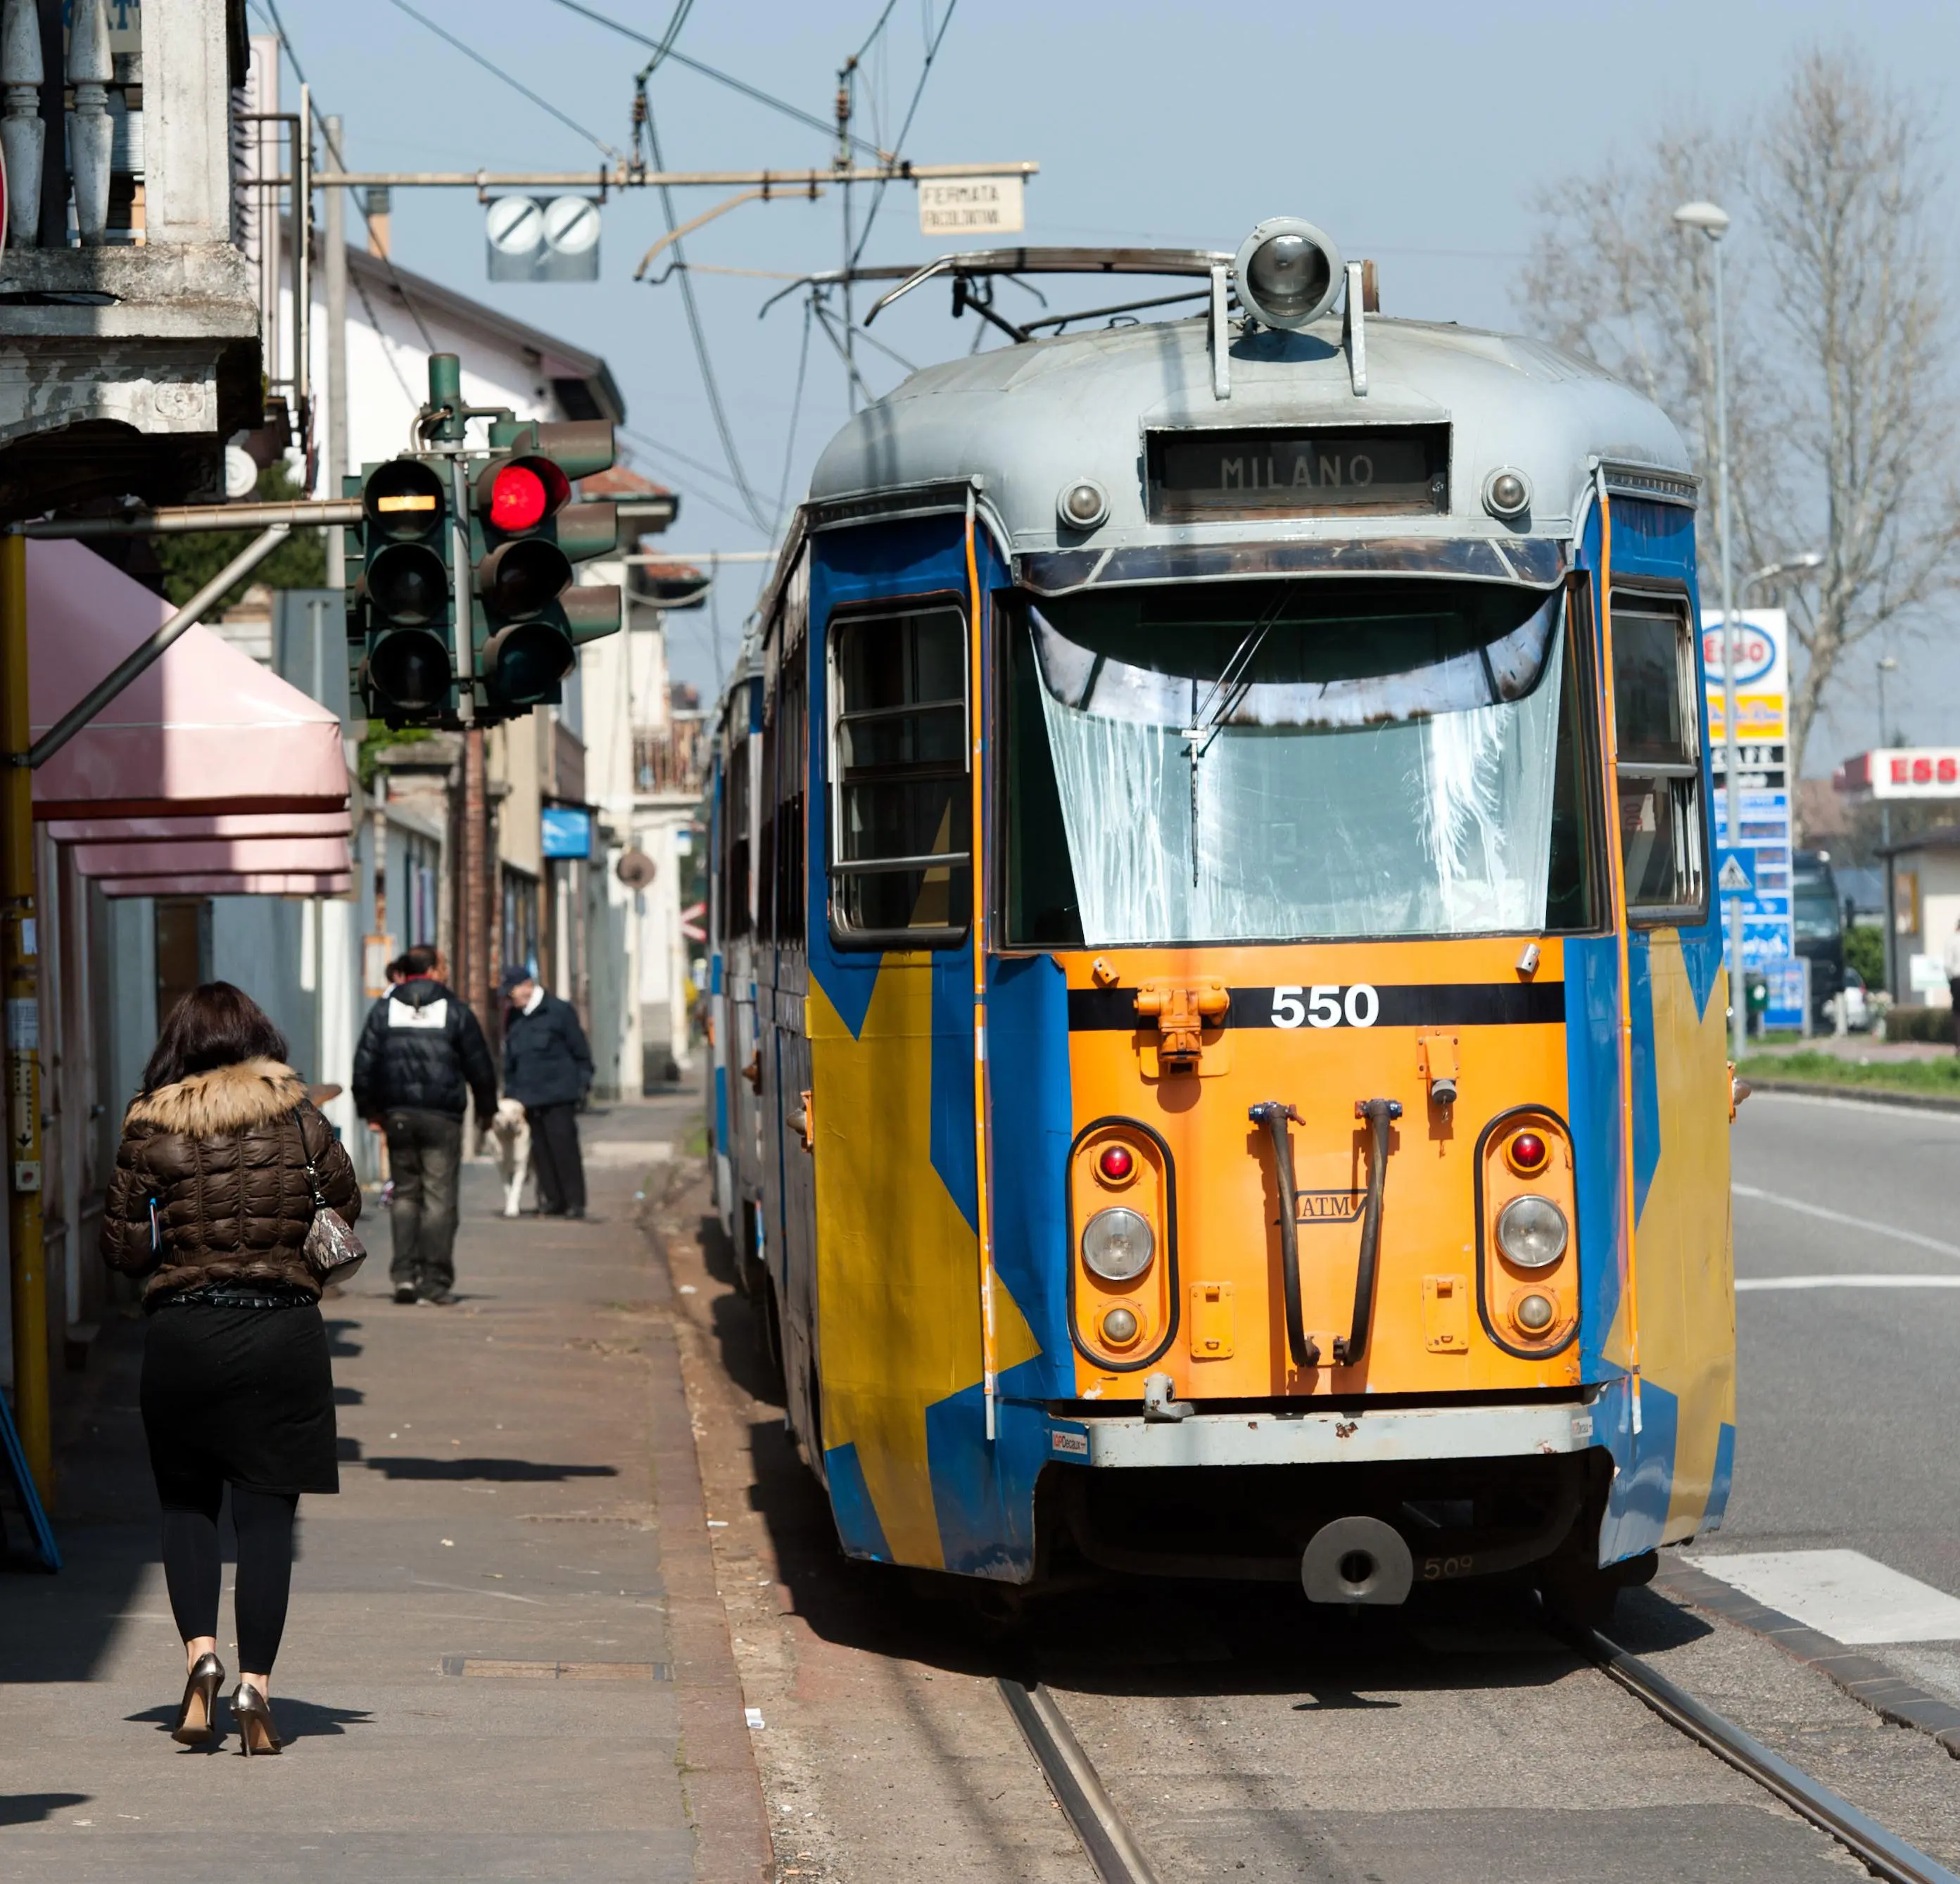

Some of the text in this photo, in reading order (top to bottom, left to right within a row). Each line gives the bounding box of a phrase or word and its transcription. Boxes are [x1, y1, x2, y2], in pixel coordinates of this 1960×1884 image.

[923, 185, 1000, 205] FERMATA
[1220, 454, 1373, 491] MILANO
[1270, 983, 1379, 1029] 550
[1302, 1196, 1351, 1217] ATM
